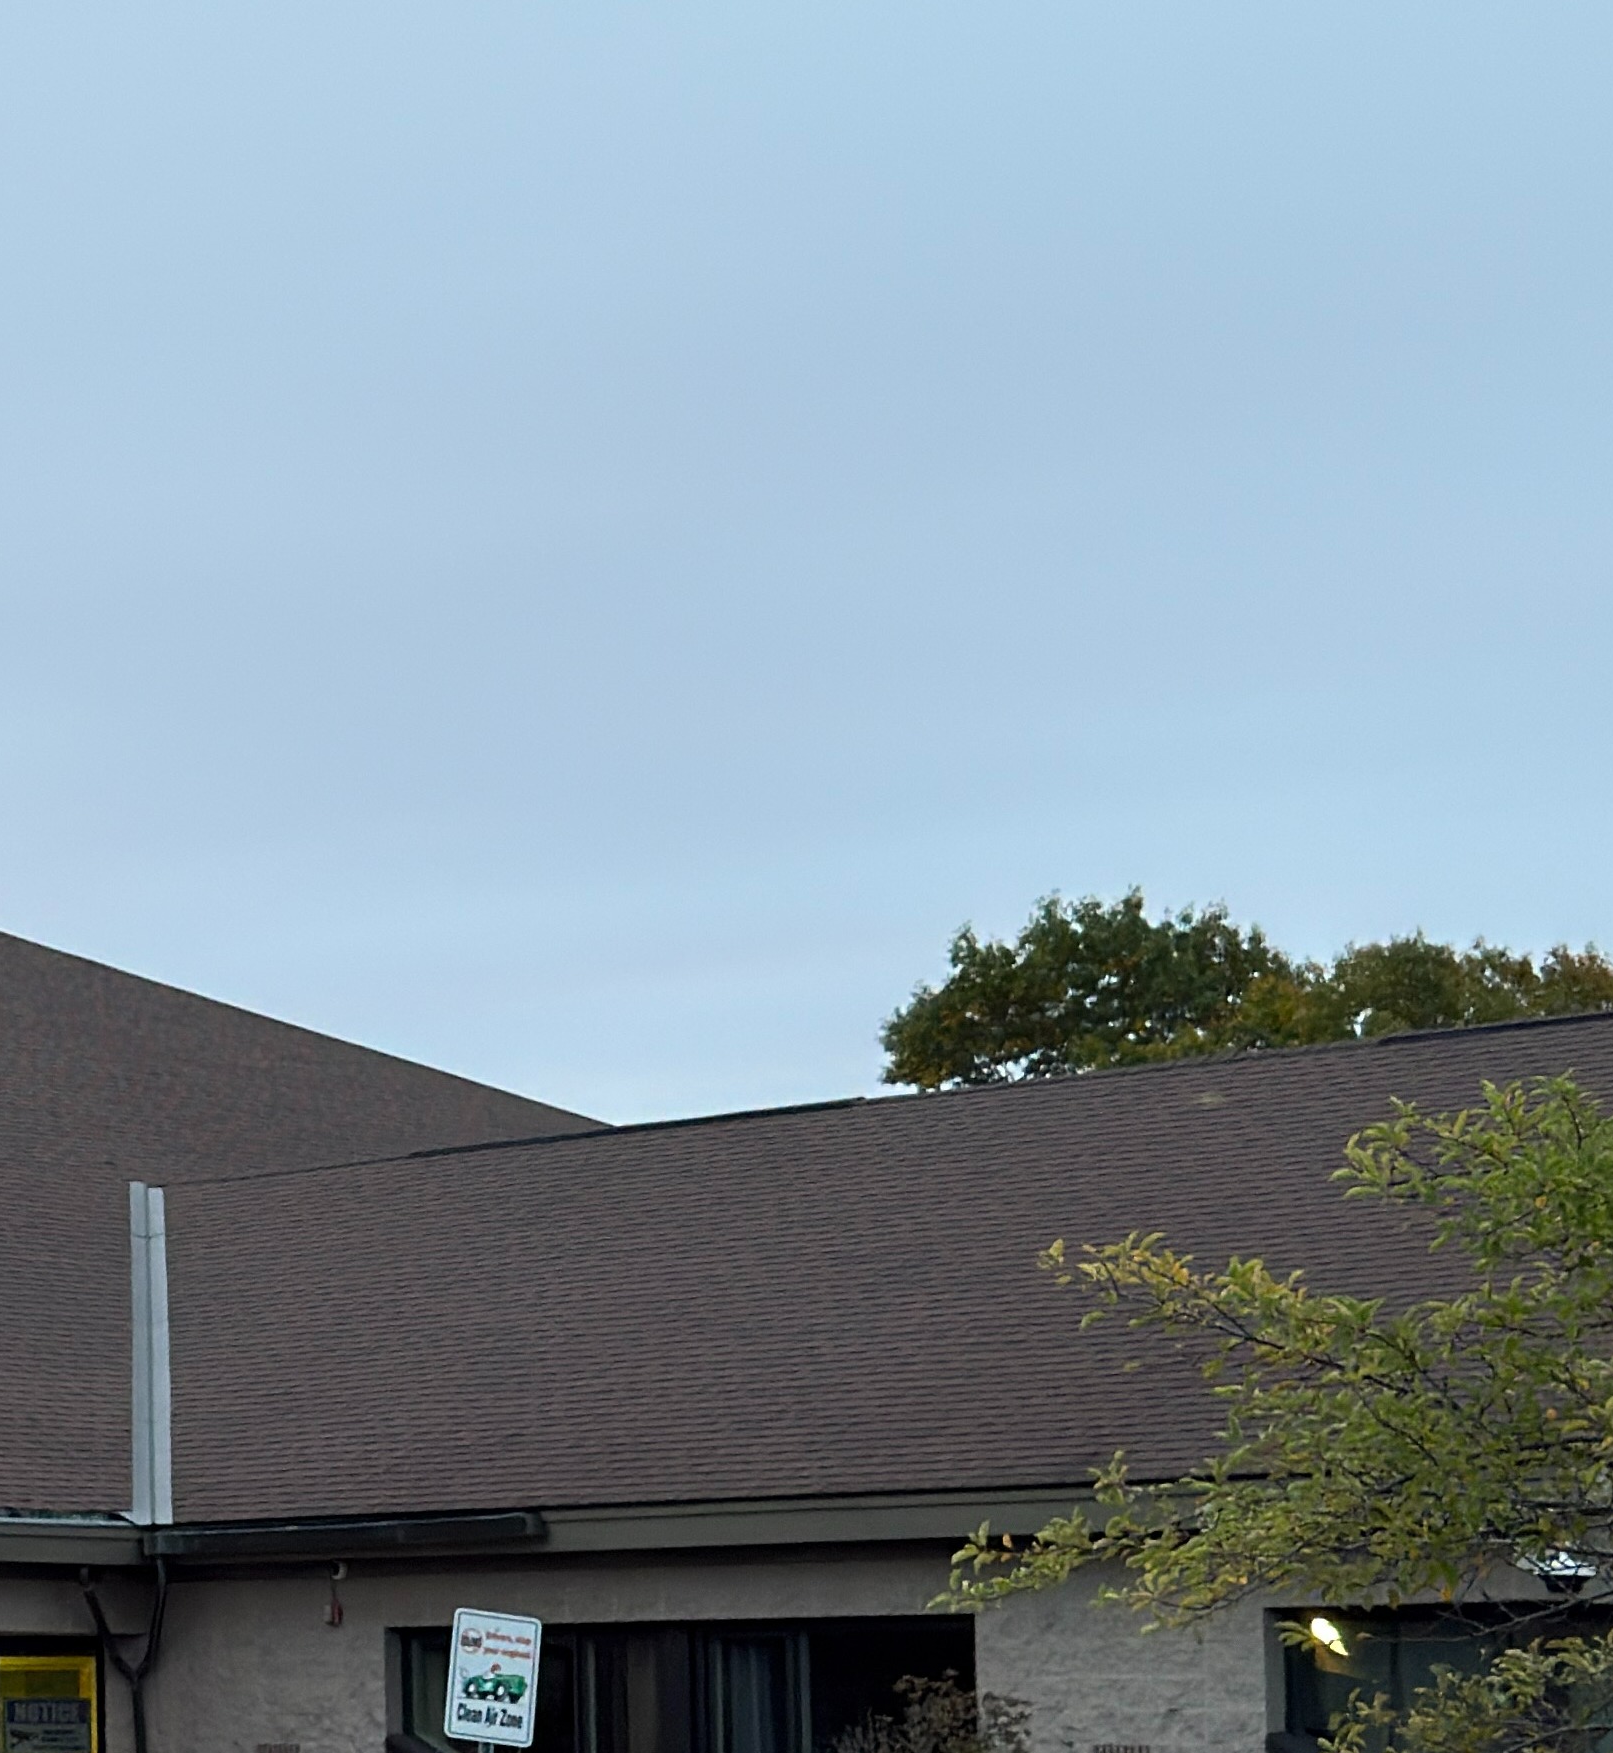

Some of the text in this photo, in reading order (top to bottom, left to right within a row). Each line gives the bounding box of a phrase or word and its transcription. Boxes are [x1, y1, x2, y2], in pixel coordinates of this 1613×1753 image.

[457, 1702, 523, 1729] Clean Air Zone
